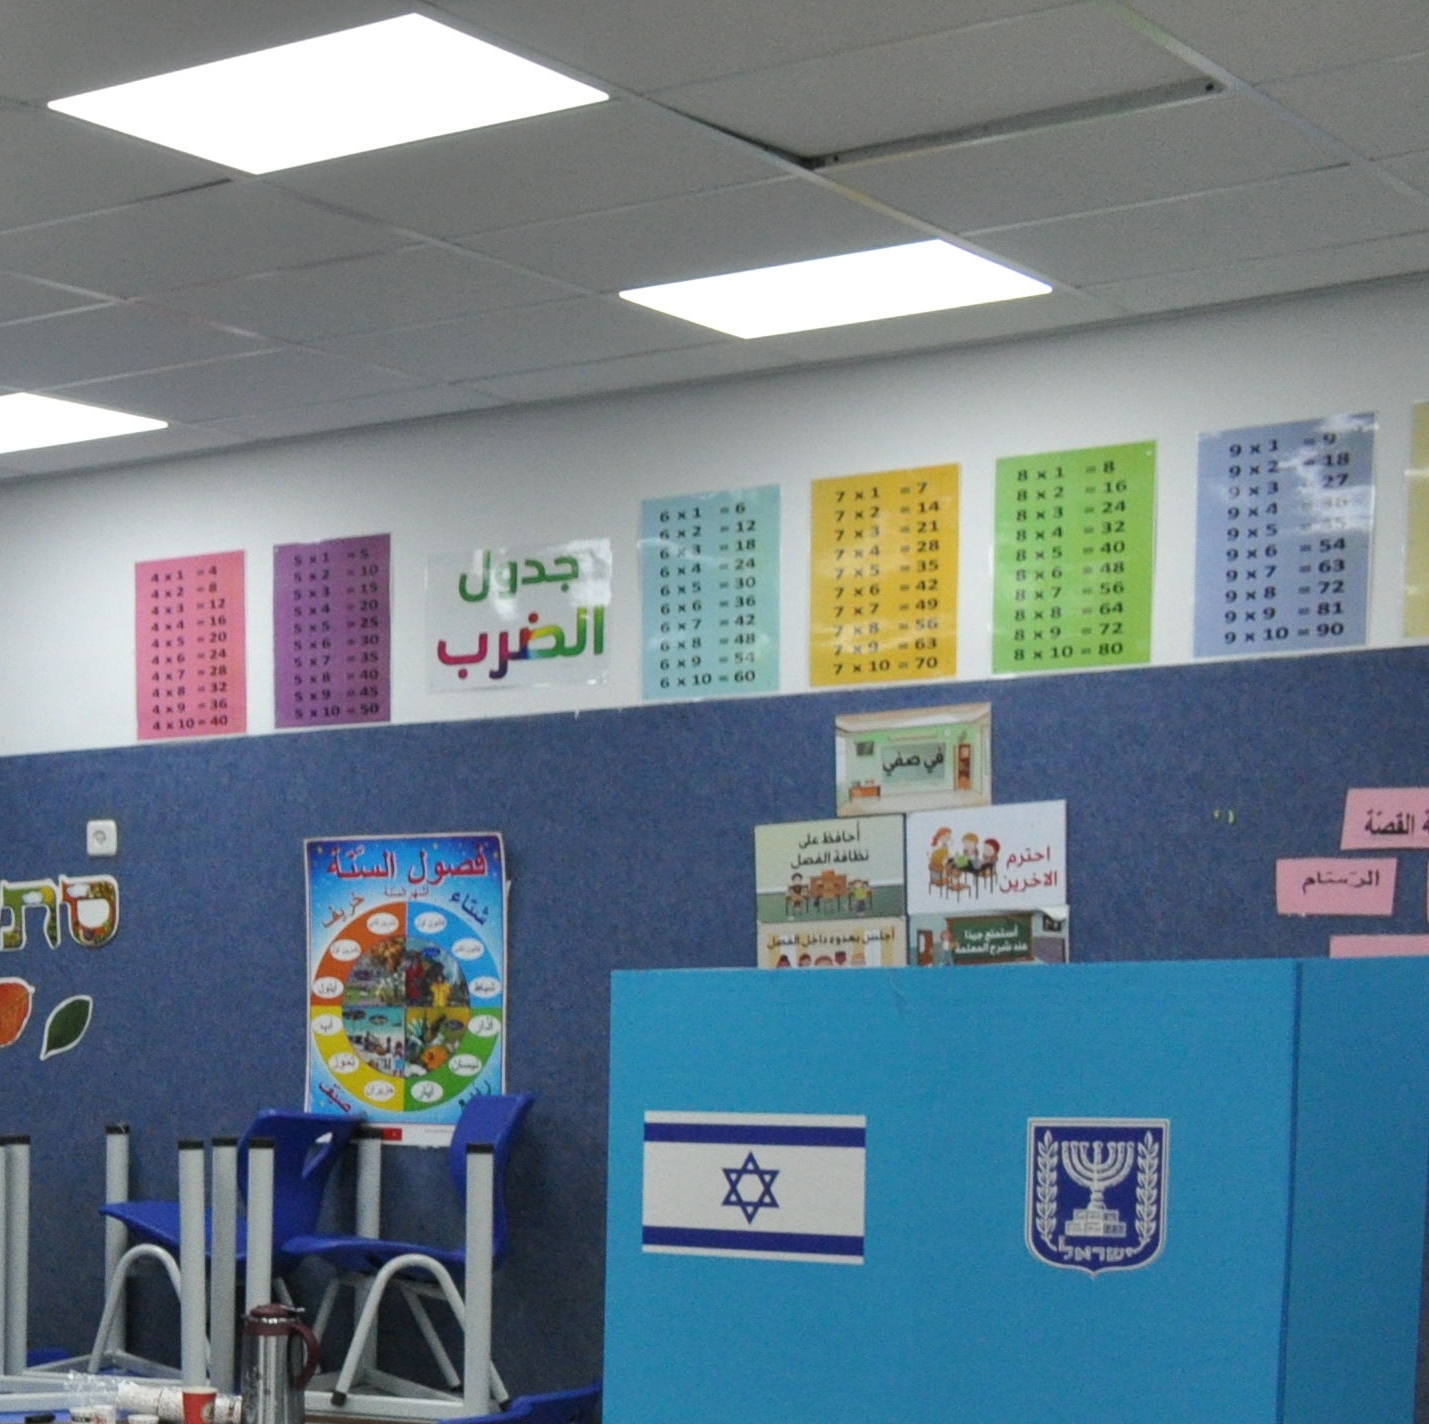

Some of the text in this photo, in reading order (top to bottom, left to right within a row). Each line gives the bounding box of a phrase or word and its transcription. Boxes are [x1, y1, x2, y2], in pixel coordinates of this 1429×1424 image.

[1229, 444, 1241, 457] 9
[1269, 440, 1278, 452] 1
[1323, 433, 1336, 445] 9
[1017, 470, 1028, 481] 8
[1055, 467, 1063, 478] 1
[1103, 461, 1114, 473] 8
[836, 491, 844, 502] 7
[871, 487, 879, 497] 1
[917, 482, 928, 494] 7
[660, 511, 669, 522] 6
[693, 508, 701, 518] 1
[736, 502, 745, 514] 6
[835, 510, 844, 522] 7
[871, 506, 880, 517] 2
[917, 501, 939, 513] 14
[1016, 529, 1027, 541] 8
[1054, 527, 1064, 538] 4
[1102, 522, 1126, 534] 32
[1227, 548, 1238, 561] 9
[1266, 544, 1278, 556] 6
[1320, 539, 1347, 552] 54
[151, 573, 159, 582] 4
[177, 571, 183, 579] 1
[209, 566, 217, 575] 4
[459, 550, 579, 602] جدول
[660, 567, 669, 578] 6
[693, 563, 702, 574] 4
[735, 558, 756, 570] 24
[1226, 569, 1238, 582] 9
[1266, 565, 1277, 577] 7
[1319, 560, 1346, 573] 63
[835, 587, 844, 598] 7
[870, 583, 879, 594] 6
[916, 579, 938, 591] 42
[1015, 609, 1025, 621] 8
[1052, 606, 1062, 618] 8
[1099, 602, 1124, 615] 64
[152, 623, 159, 631] 4
[178, 620, 185, 629] 4
[209, 616, 227, 625] 16
[660, 622, 669, 633] 6
[693, 618, 702, 630] 7
[735, 614, 756, 626] 42
[1224, 632, 1236, 644] 9
[1264, 627, 1289, 640] 10
[1317, 623, 1344, 638] 90
[437, 605, 604, 679] الضرب
[1014, 649, 1025, 661] 8
[1051, 646, 1073, 658] 10
[1098, 643, 1123, 655] 80
[834, 664, 843, 675] 7
[870, 659, 890, 671] 10
[916, 657, 938, 669] 70
[660, 678, 669, 689] 6
[693, 673, 712, 685] 10
[734, 670, 755, 682] 60
[152, 722, 160, 730] 4
[179, 719, 194, 729] 10
[210, 715, 228, 726] 40
[882, 746, 945, 776] في صفي
[798, 820, 860, 849] أحافظ على
[408, 843, 488, 886] فصول
[791, 848, 869, 869] نظافة الفصل
[1006, 846, 1051, 869] احترم
[999, 870, 1058, 893] الاخرين
[322, 891, 365, 928] خريف
[449, 891, 490, 925] شتاء
[319, 1082, 352, 1113] صيف
[1058, 1235, 1134, 1261] ישראל
